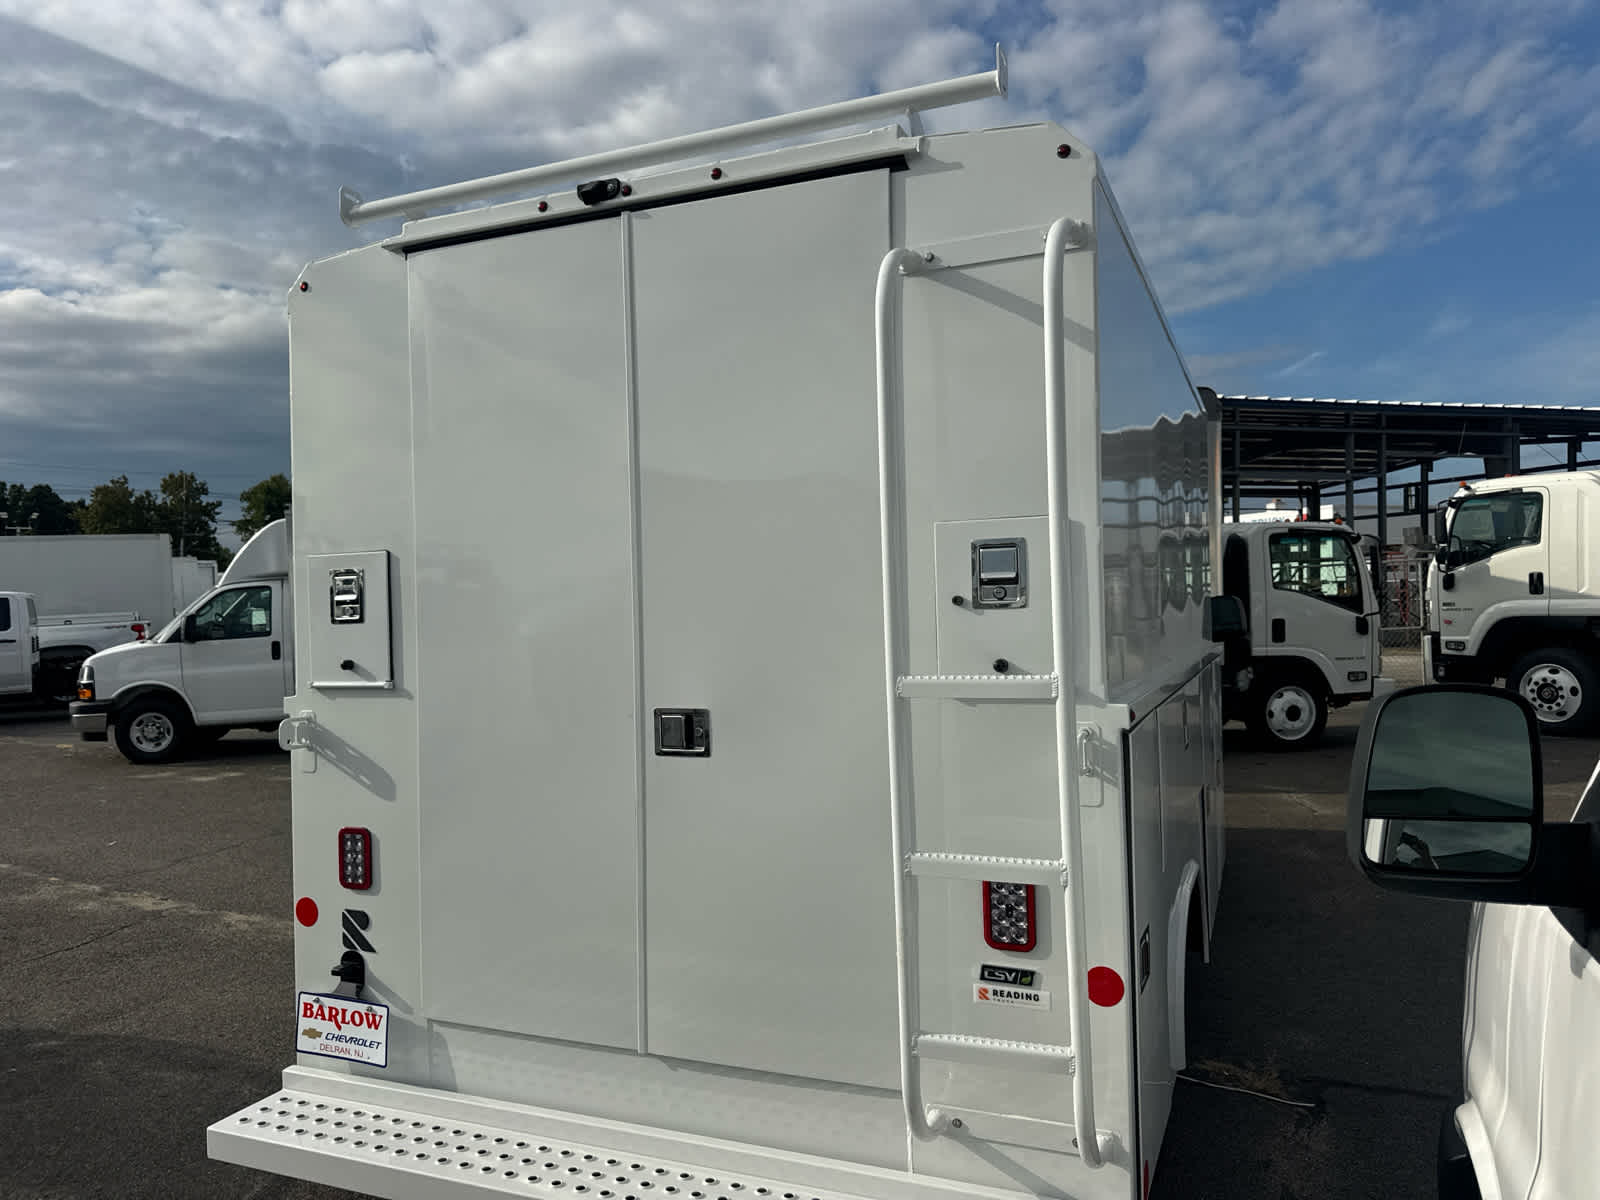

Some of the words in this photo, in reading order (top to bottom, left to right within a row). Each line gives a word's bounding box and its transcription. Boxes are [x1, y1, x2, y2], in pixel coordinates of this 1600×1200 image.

[992, 988, 1040, 1002] READING
[301, 1001, 383, 1031] BARLOW
[325, 1032, 382, 1049] CHEVROLET
[319, 1043, 353, 1057] DELRAN,
[354, 1049, 364, 1057] NJ
